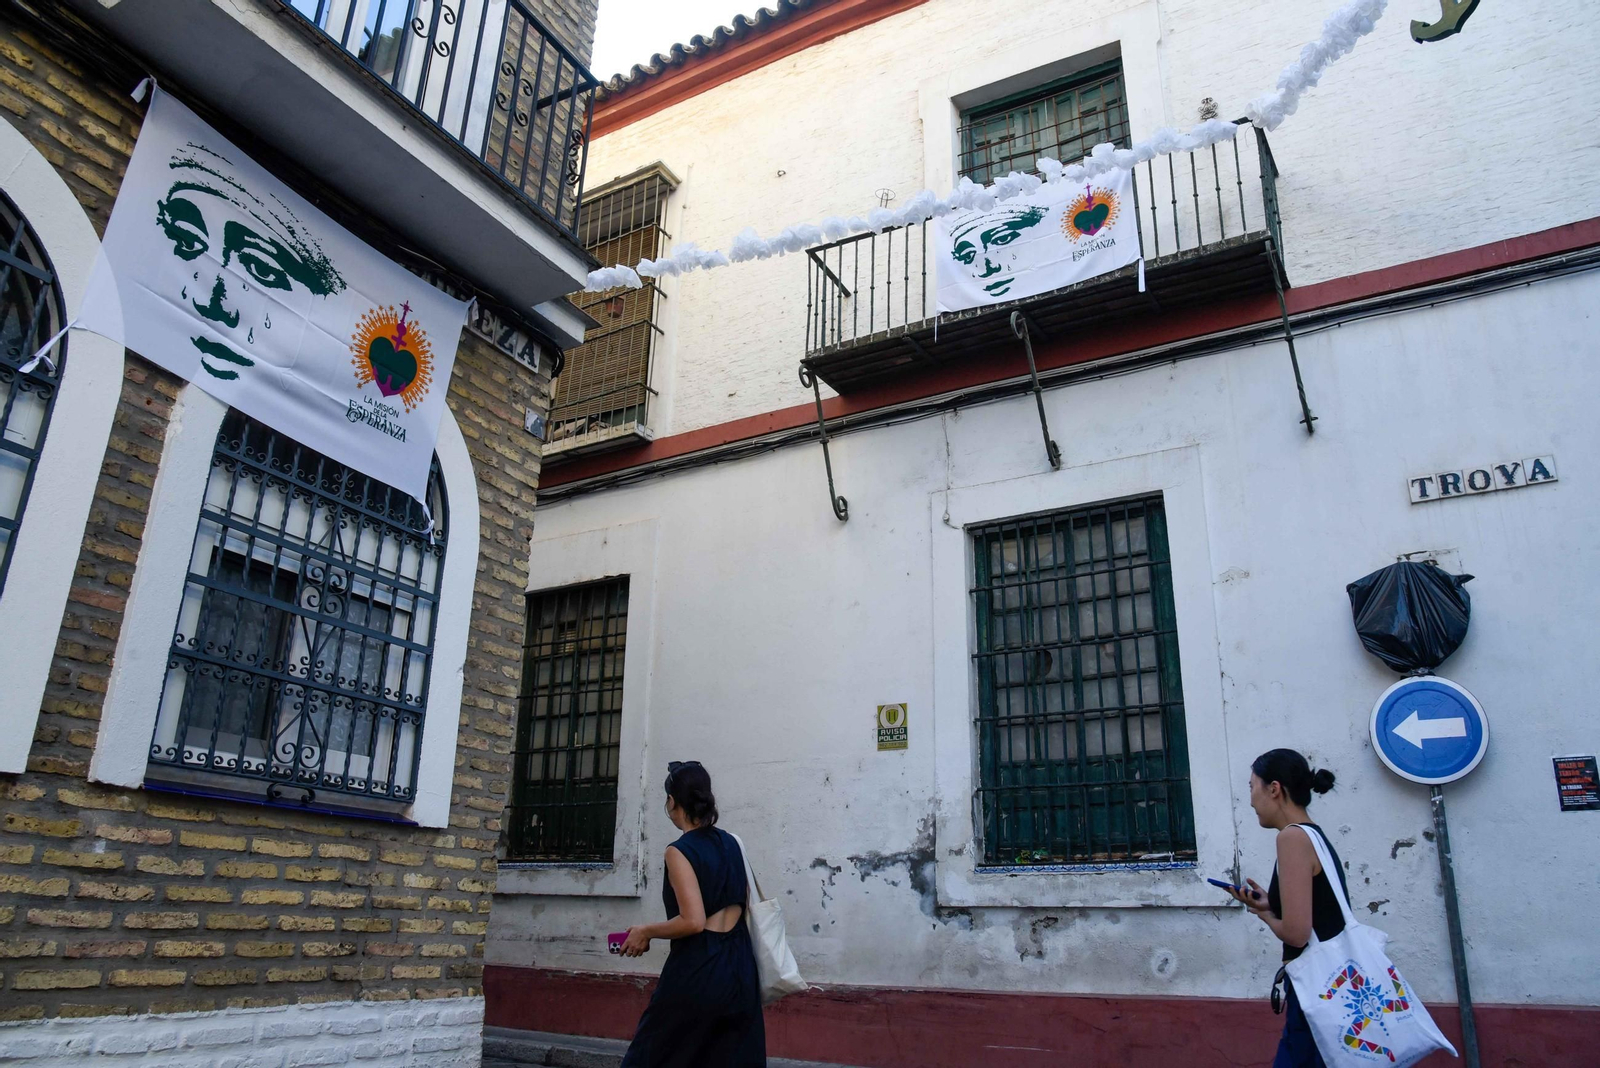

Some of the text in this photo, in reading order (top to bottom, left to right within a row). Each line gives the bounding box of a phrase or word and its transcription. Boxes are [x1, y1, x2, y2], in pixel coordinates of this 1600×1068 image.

[1072, 238, 1116, 261] ESPERANZA
[363, 395, 400, 418] LA MISIÓN
[346, 398, 407, 443] ESPERANZA
[1411, 458, 1555, 498] TROYA
[878, 733, 907, 742] POLICIA
[880, 727, 905, 736] AVISO
